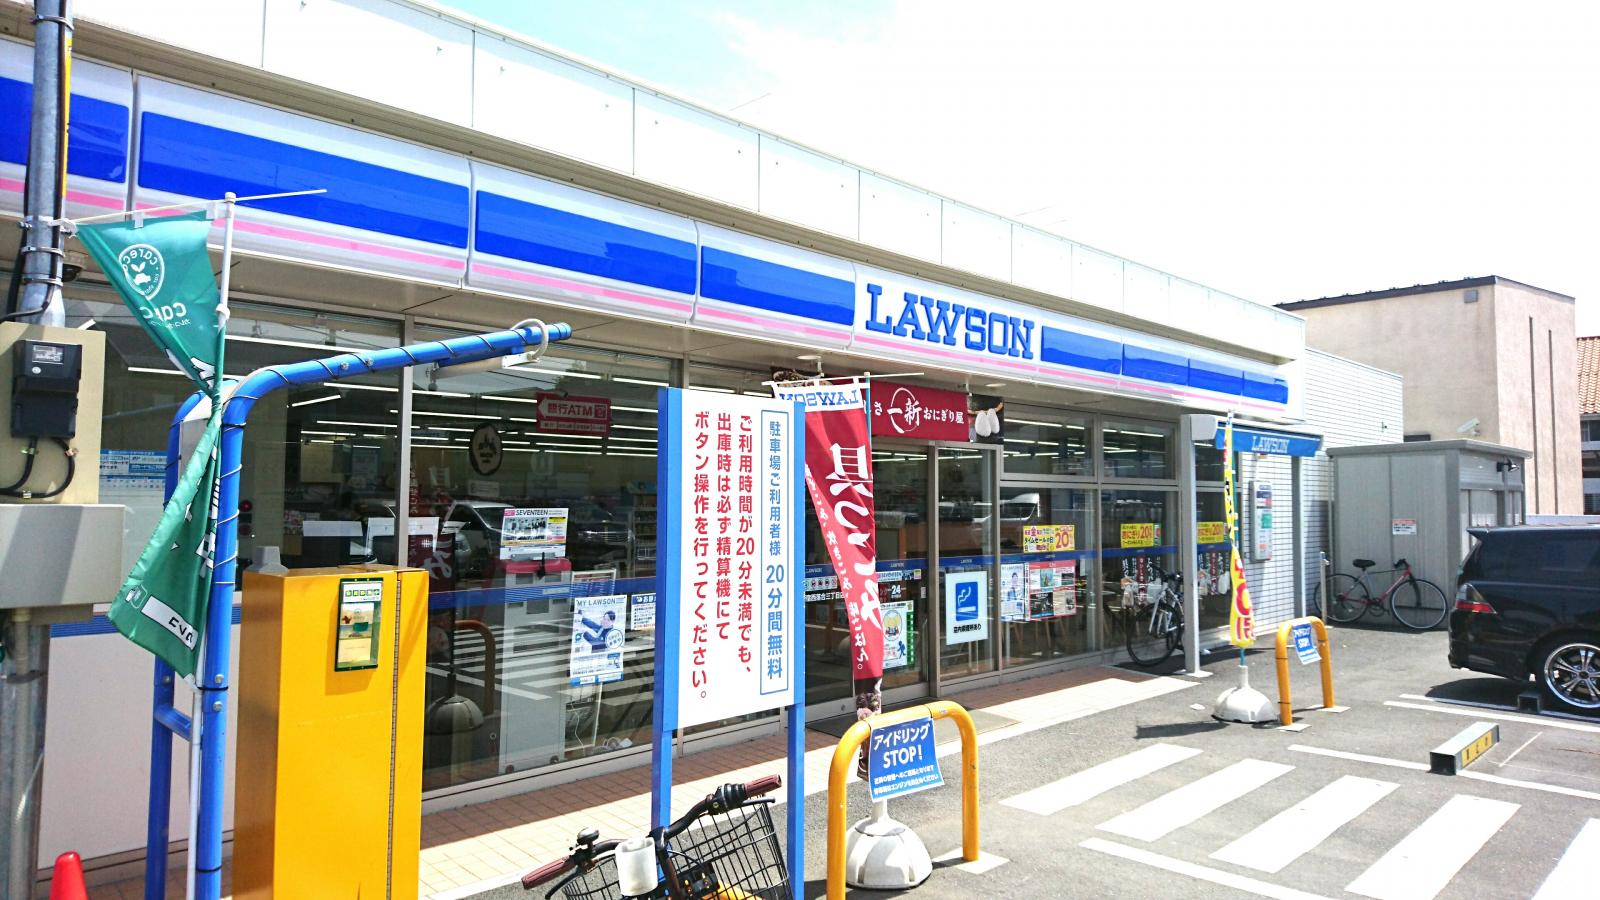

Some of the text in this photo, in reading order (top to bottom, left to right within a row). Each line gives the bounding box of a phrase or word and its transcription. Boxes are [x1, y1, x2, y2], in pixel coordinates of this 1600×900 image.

[865, 283, 1034, 359] LAWSON
[924, 407, 965, 425] おにぎり屋
[1251, 435, 1290, 454] LAWSON
[716, 413, 732, 640] 出庫時は必ず精算機にて
[1055, 531, 1069, 549] 20
[692, 411, 710, 699] ボタン操作を行ってください。
[736, 415, 755, 672] ご利用時間が20分未満でも、
[766, 421, 785, 680] 駐車場ご利用者様 20分間無料
[588, 597, 616, 606] LAWSON
[890, 584, 901, 595] 24
[873, 722, 931, 751] アイドリング
[883, 744, 923, 769] STOP!
